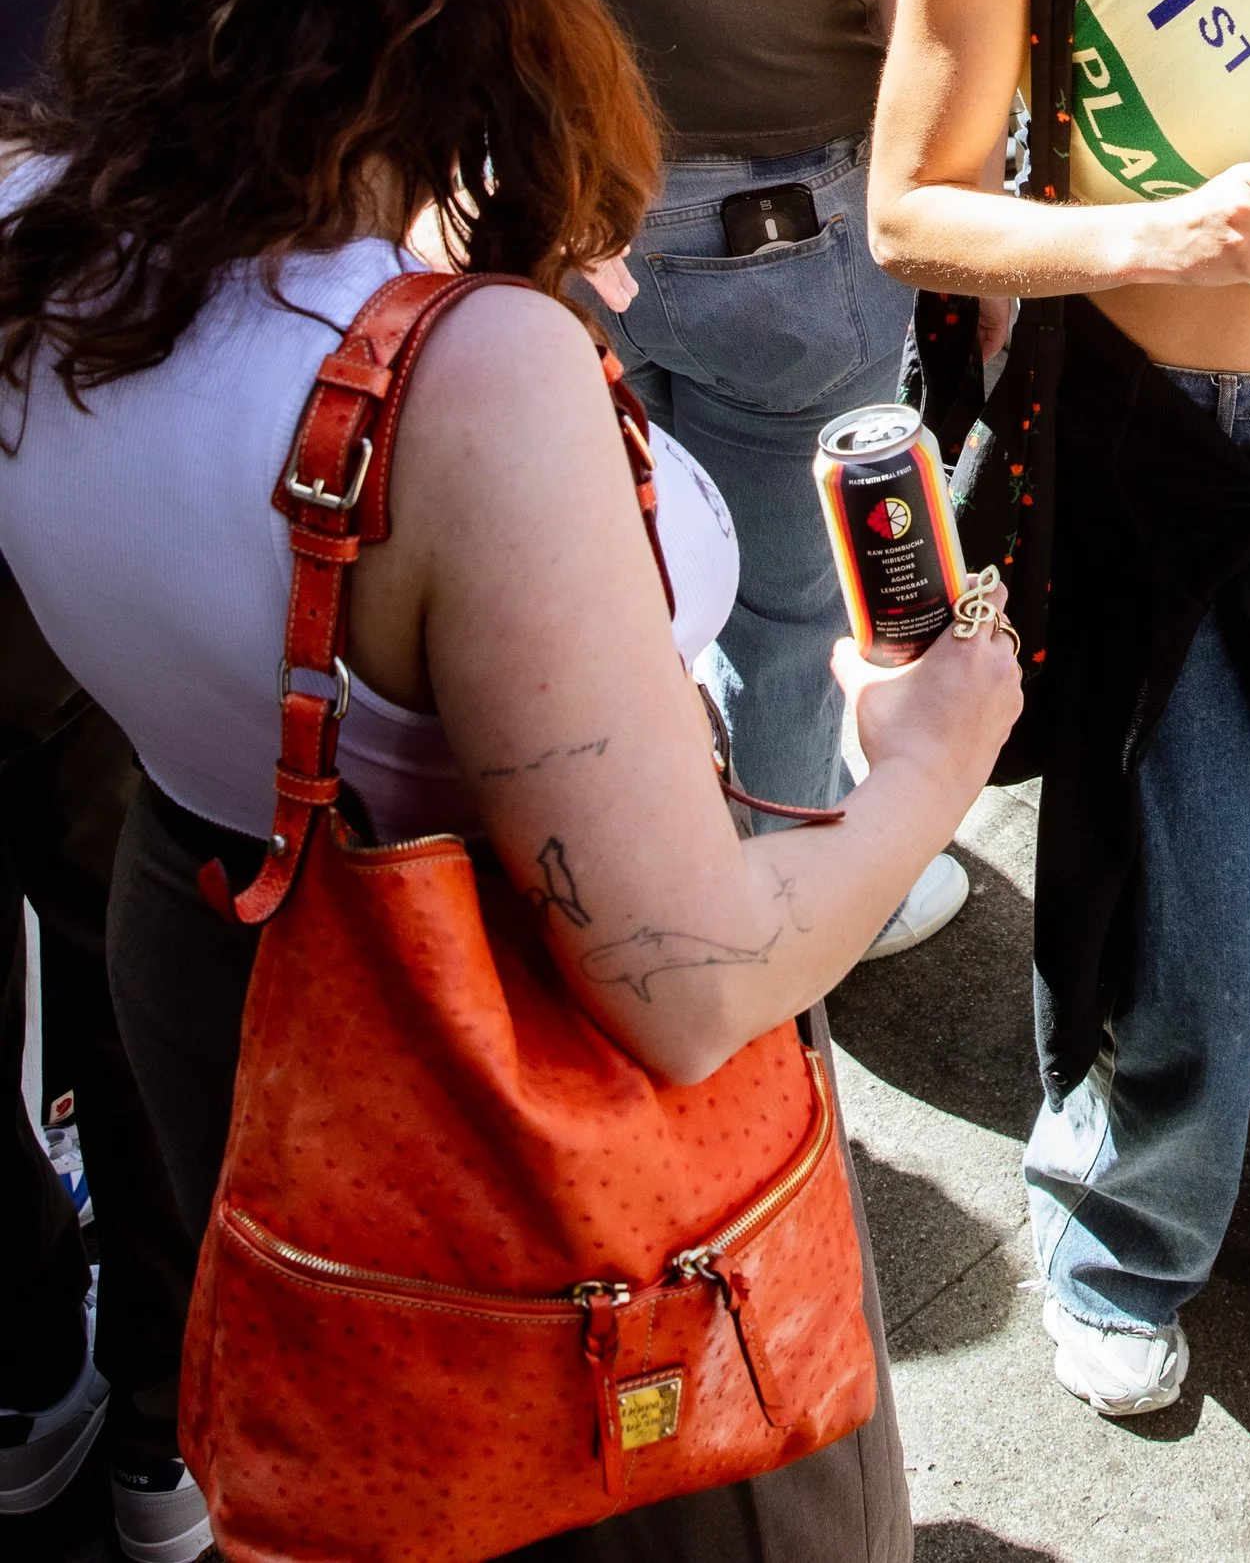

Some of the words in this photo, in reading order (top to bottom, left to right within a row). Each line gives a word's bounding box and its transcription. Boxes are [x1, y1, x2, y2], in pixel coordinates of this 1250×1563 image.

[848, 478, 865, 486] MADE
[865, 476, 881, 485] WITH
[881, 472, 896, 482] REAL
[896, 465, 912, 477] FRUIT
[867, 549, 883, 557] RAW
[885, 538, 925, 555] KOMBUCHA
[881, 552, 915, 565] HIBISCUS
[885, 562, 916, 574] LEMONS
[891, 573, 915, 583] AGAVE
[880, 578, 929, 594] LEMONGRASS
[895, 591, 918, 602] YEAST
